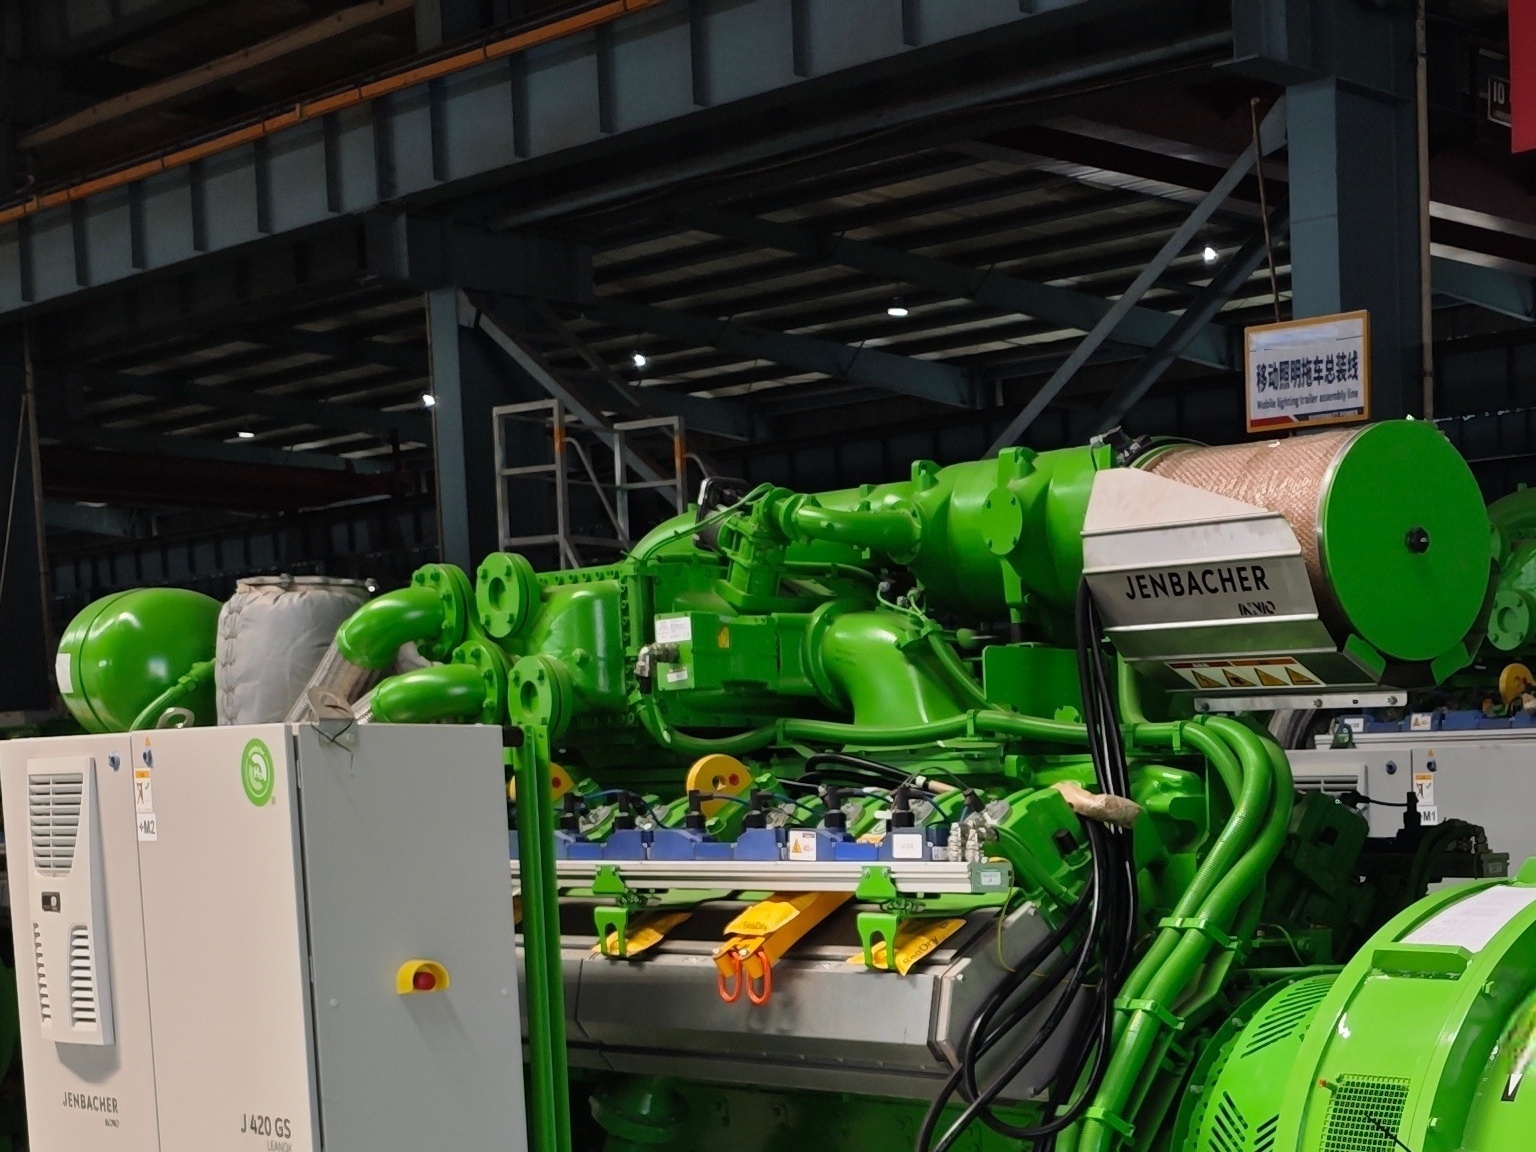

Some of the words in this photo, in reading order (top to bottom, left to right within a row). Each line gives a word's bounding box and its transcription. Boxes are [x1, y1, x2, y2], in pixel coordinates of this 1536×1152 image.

[1256, 350, 1358, 393] 移动照明拖车总装线
[1126, 565, 1270, 600] JENBACHER
[1421, 810, 1436, 821] M1
[62, 1091, 119, 1114] JENBACHER
[241, 1113, 247, 1134] J
[250, 1114, 272, 1137] 420
[275, 1117, 291, 1139] GS
